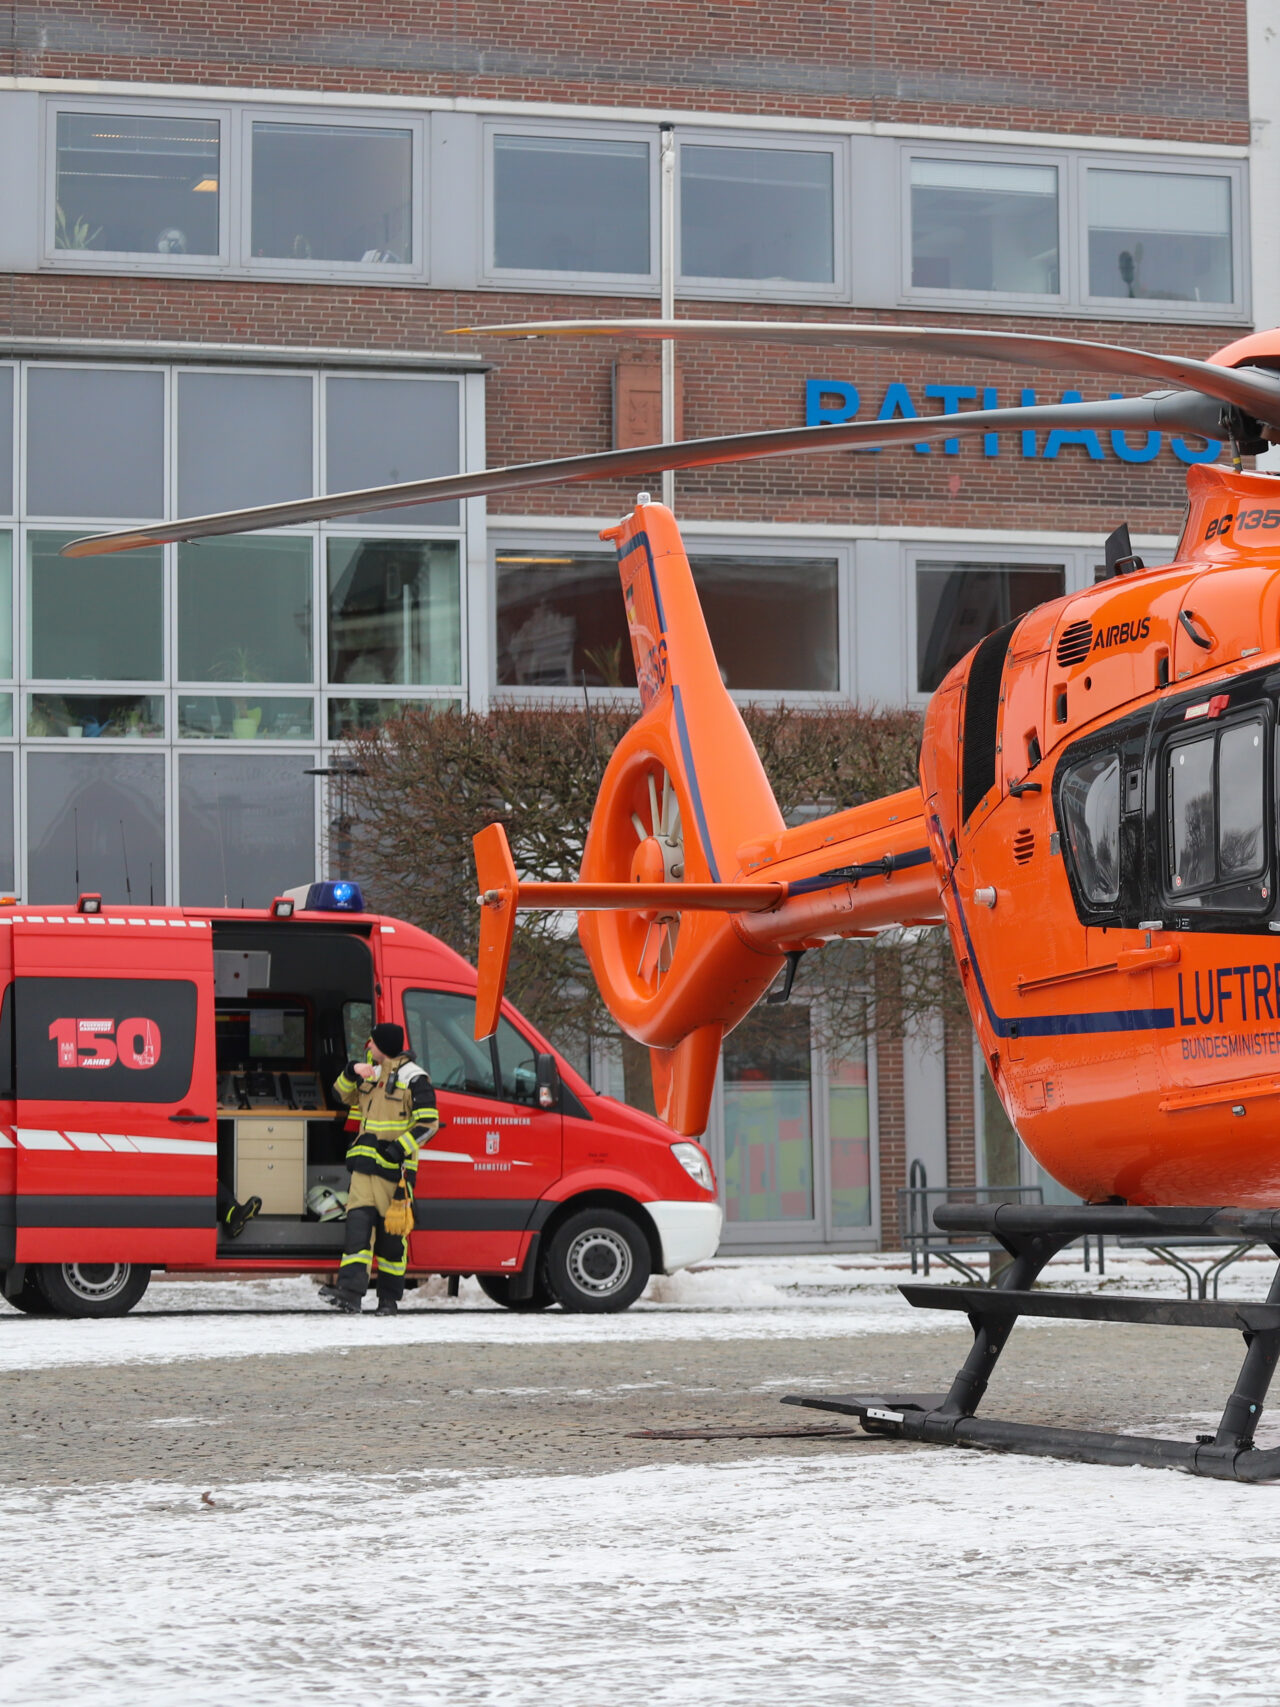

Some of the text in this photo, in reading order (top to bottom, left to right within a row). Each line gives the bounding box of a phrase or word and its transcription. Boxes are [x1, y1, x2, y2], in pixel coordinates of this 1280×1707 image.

[1092, 616, 1151, 651] AIRBUS
[48, 1017, 162, 1070] 150
[82, 1058, 111, 1066] JAHRE
[453, 1116, 531, 1126] FREIWILLIGE FEUERWEHR
[474, 1163, 511, 1172] BARMSTEDT
